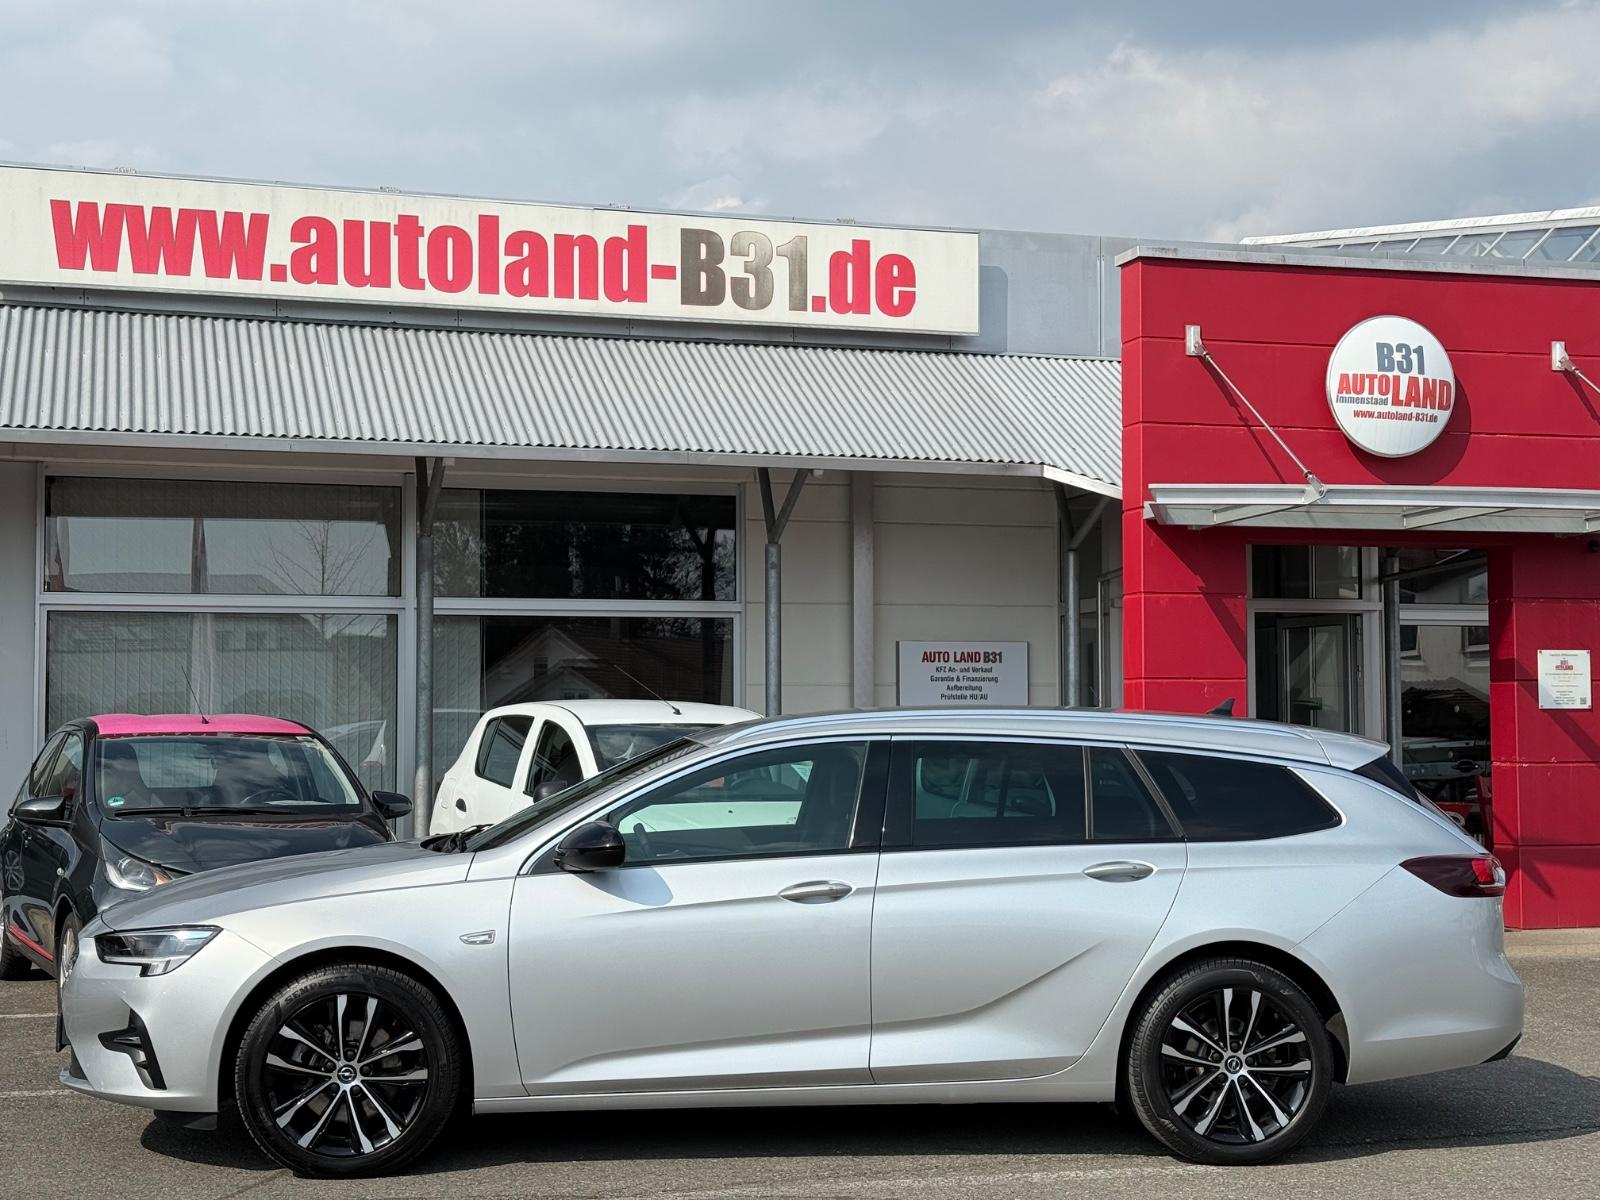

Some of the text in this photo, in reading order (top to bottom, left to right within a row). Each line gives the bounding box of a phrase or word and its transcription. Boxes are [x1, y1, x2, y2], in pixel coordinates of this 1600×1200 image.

[50, 198, 916, 318] www.autoland-B31.de
[1376, 342, 1425, 375] B31
[1353, 409, 1438, 423] www.autoland-B31.de
[922, 651, 1003, 663] AUTO LAND B31
[962, 675, 999, 683] Finanzierung
